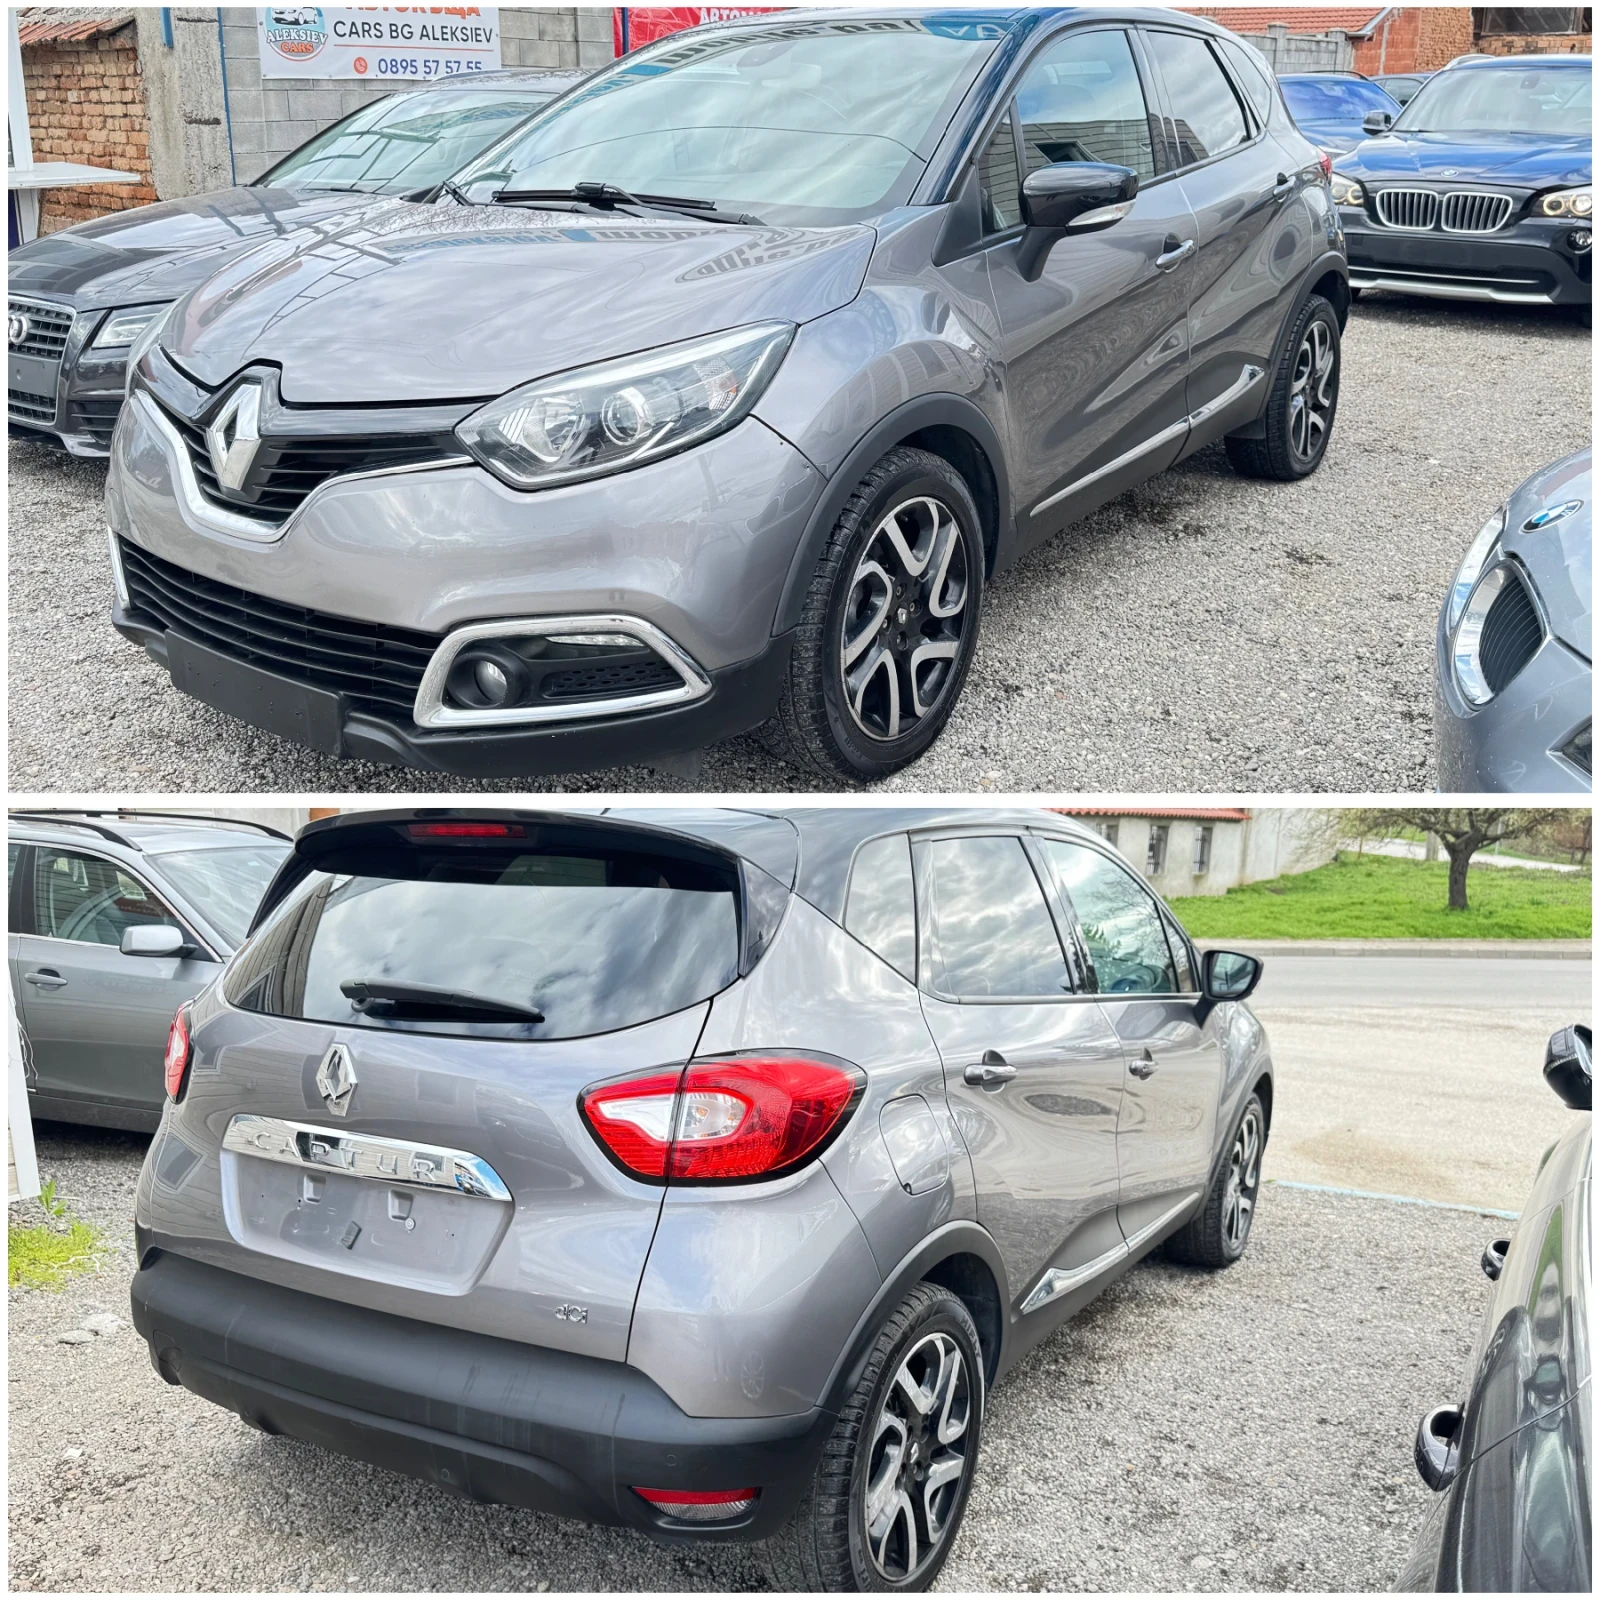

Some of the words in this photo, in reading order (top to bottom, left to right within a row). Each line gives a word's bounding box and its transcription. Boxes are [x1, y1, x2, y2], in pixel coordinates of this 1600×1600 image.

[266, 28, 328, 45] ALEKSIEV
[333, 20, 383, 39] CARS
[389, 23, 414, 40] BG
[419, 24, 493, 43] ALEKSIEV
[281, 42, 314, 53] CARS
[378, 58, 418, 75] 0895
[423, 59, 440, 75] 57
[445, 60, 461, 74] 57
[253, 1130, 437, 1182] CAPTUR
[554, 1303, 588, 1324] dCi
